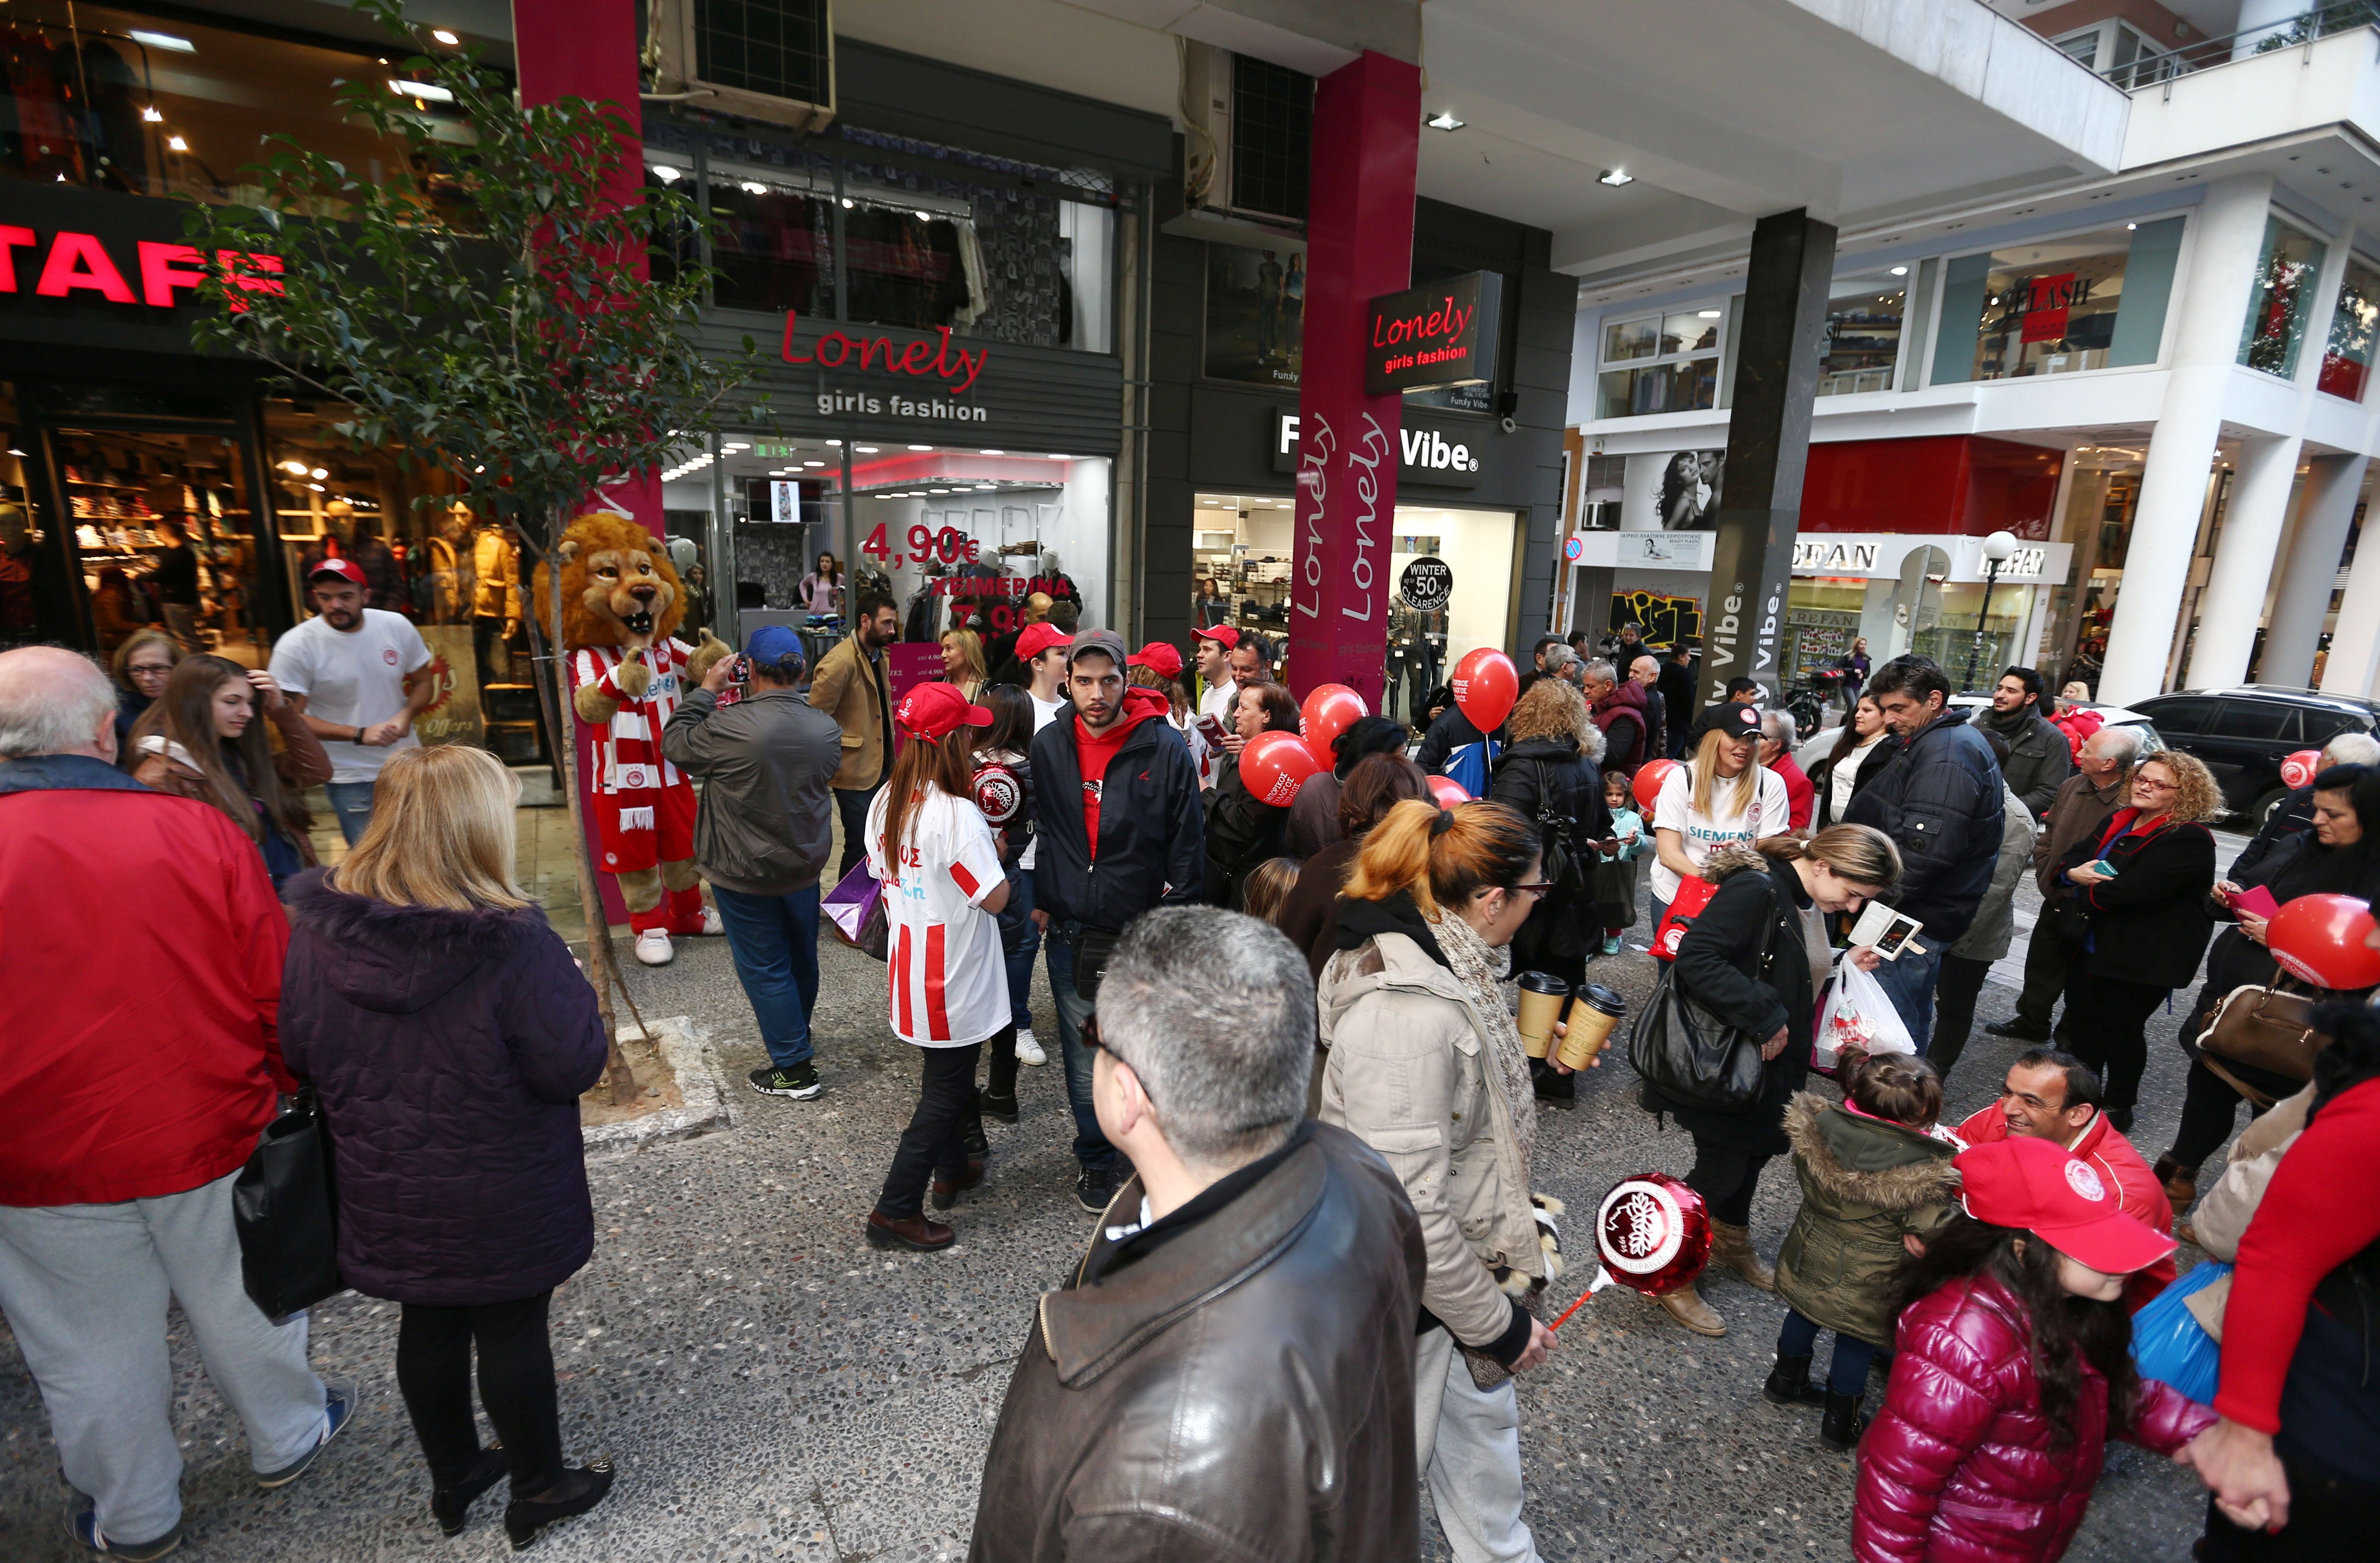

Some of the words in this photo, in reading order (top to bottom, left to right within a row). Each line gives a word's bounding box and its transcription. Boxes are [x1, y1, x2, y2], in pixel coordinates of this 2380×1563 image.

[1373, 297, 1471, 348] Lonely
[782, 309, 987, 394] Lonely
[1385, 356, 1413, 373] girls
[1417, 345, 1467, 365] fashion
[817, 390, 881, 416] girls
[890, 395, 987, 422] fashion
[1297, 412, 1336, 619] Lonely
[1342, 411, 1389, 622] Lonely
[863, 523, 979, 569] 4,90€
[1410, 564, 1447, 575] WINTER
[930, 577, 1070, 596] ΧΕΙΜΕΡΙΝΑ
[1402, 585, 1450, 609] CLEARENCE
[1797, 613, 1853, 626] REFAN
[988, 774, 1018, 793] ΟΛΥΜΠΙΑΚΟΣ
[1263, 771, 1288, 802] ΕΜΠΟΡΙΚΟΣ
[1272, 777, 1294, 804] ΣΥΛΛΟΓΟΣ
[1690, 826, 1754, 841] SIEMENS
[1618, 1235, 1628, 1253] 1925
